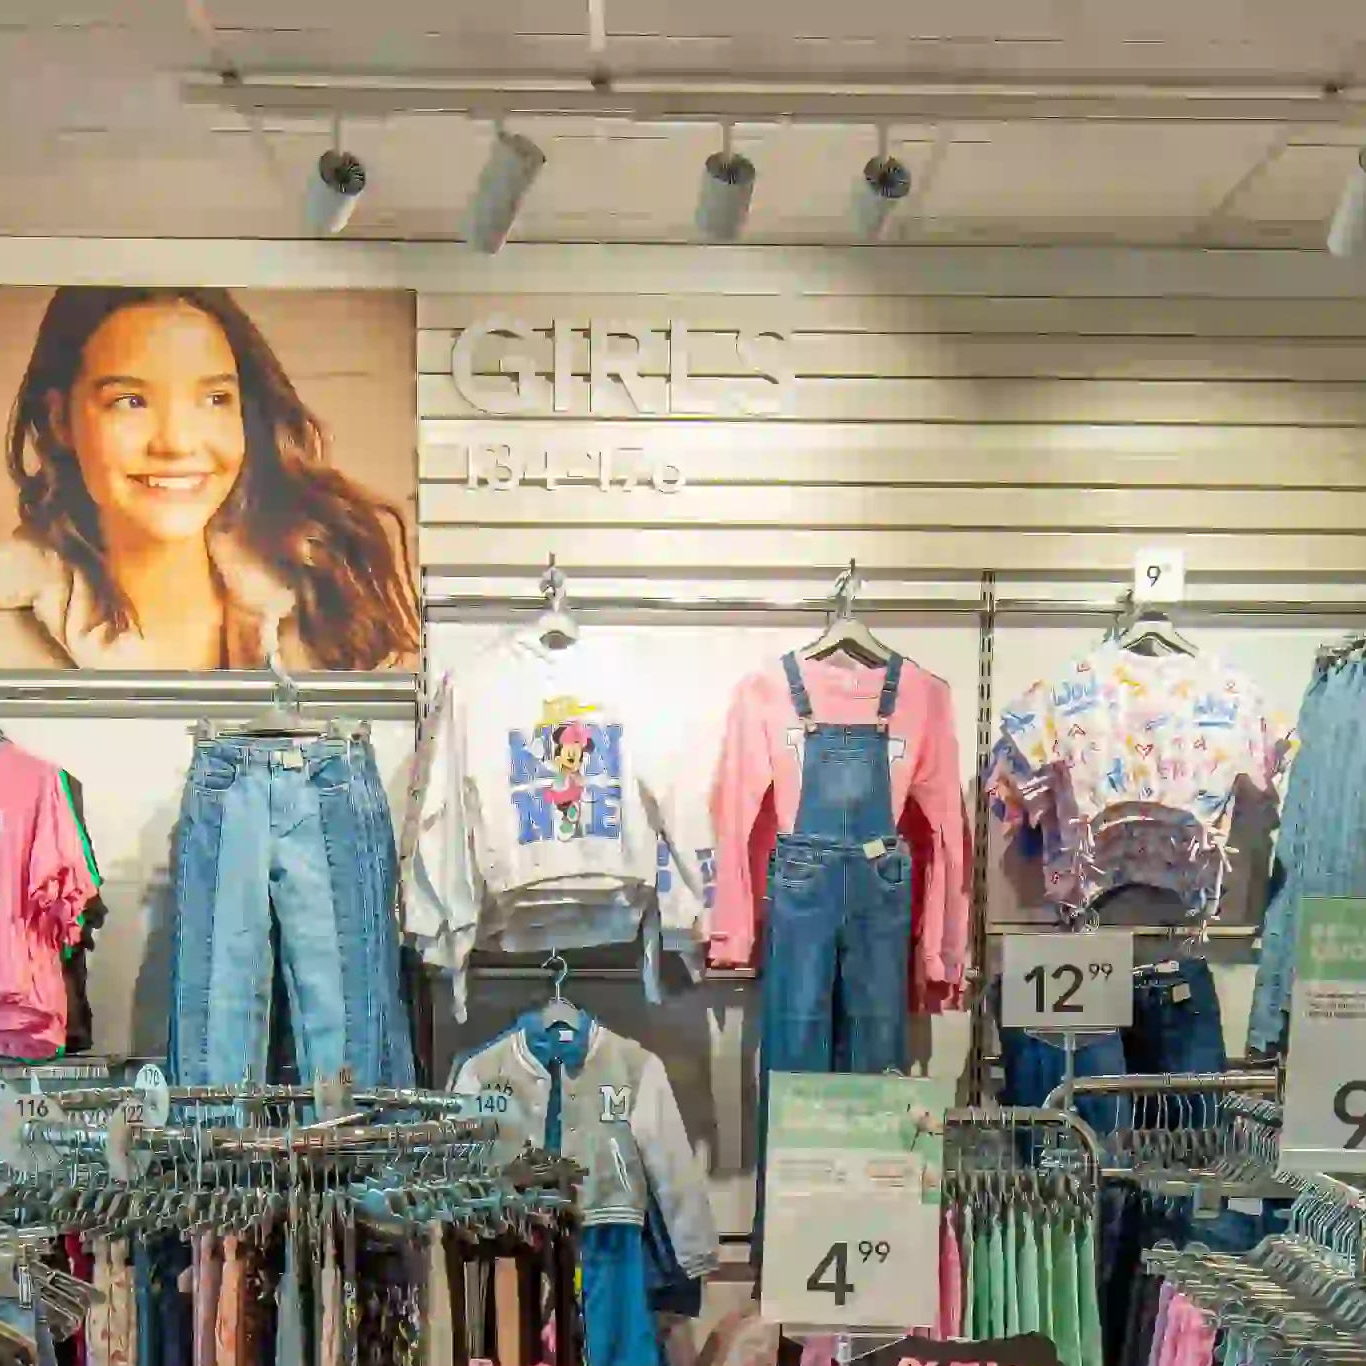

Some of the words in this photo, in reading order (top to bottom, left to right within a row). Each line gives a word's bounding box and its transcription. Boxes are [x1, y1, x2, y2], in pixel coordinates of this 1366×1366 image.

[451, 314, 797, 416] GIRLS
[1024, 963, 1084, 1013] 12
[1088, 963, 1113, 983] 99
[16, 1099, 50, 1118] 116
[475, 1095, 508, 1114] 140
[599, 1083, 631, 1123] M
[806, 1242, 855, 1306] 4
[858, 1240, 891, 1264] 99
